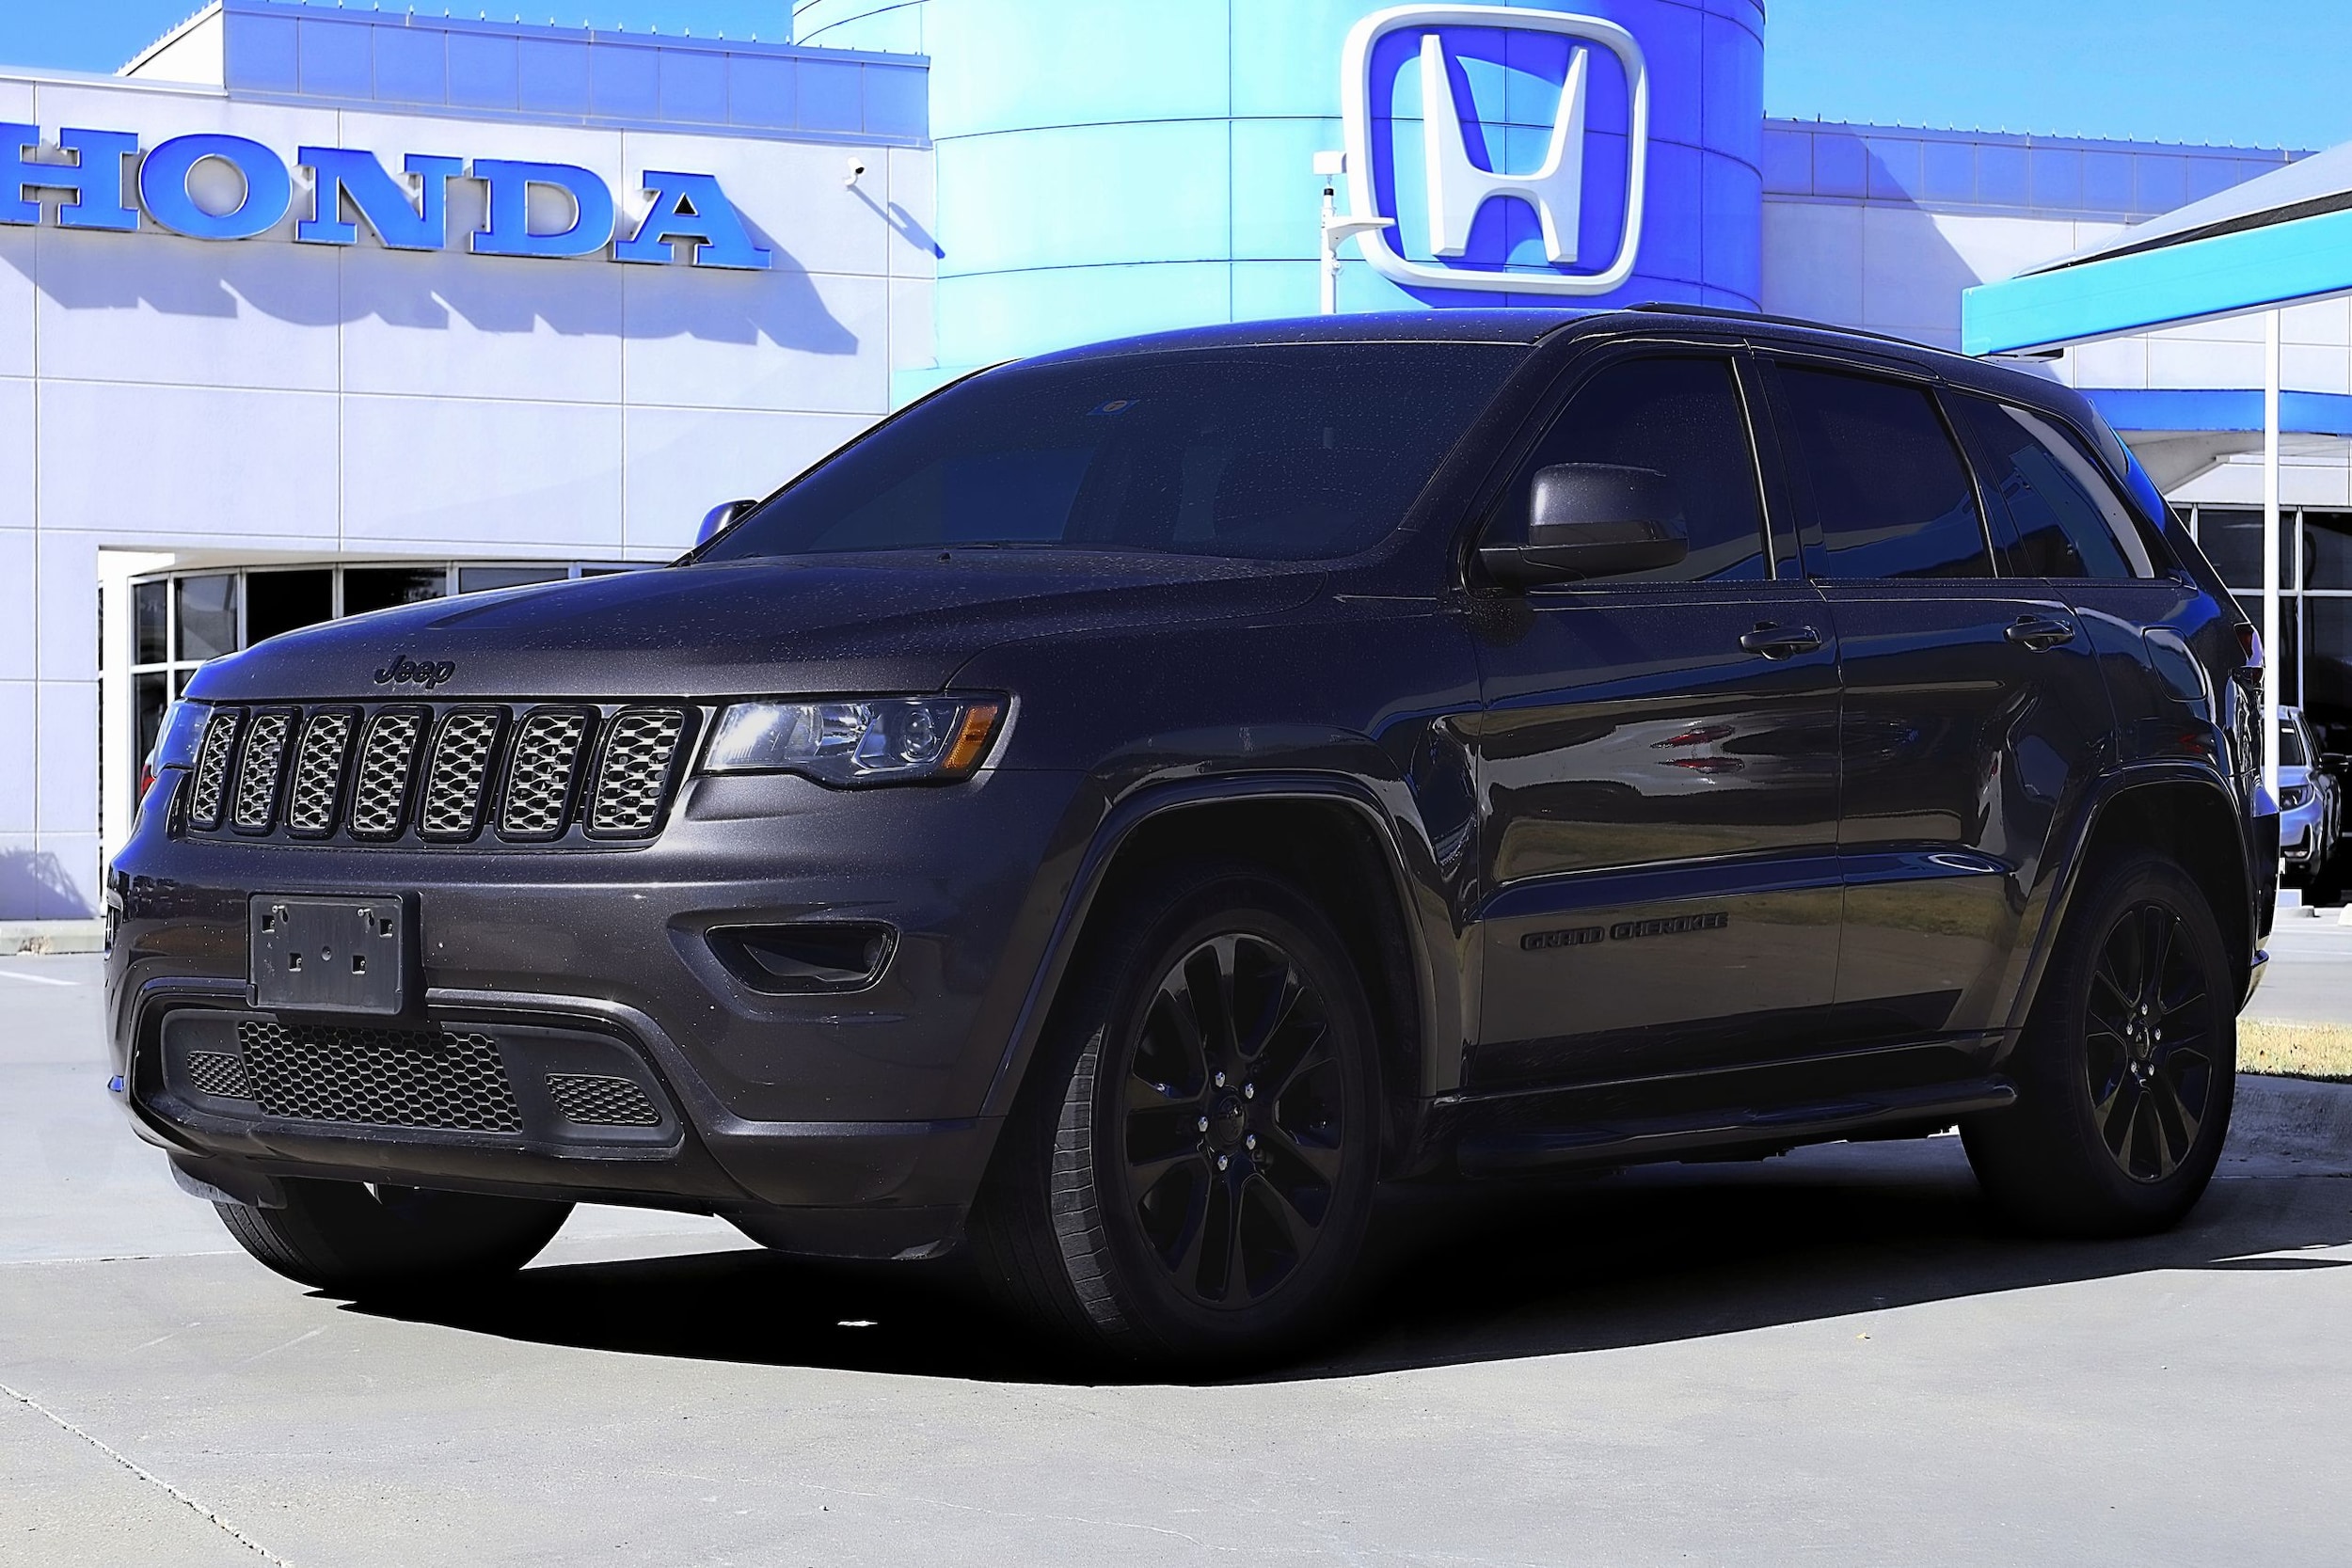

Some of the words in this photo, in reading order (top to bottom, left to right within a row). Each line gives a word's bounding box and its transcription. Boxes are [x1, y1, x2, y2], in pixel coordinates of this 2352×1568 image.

[0, 122, 772, 270] HONDA
[373, 655, 456, 689] Jeep
[1520, 926, 1605, 951] GRAND
[1610, 911, 1729, 941] CHEROKEE
